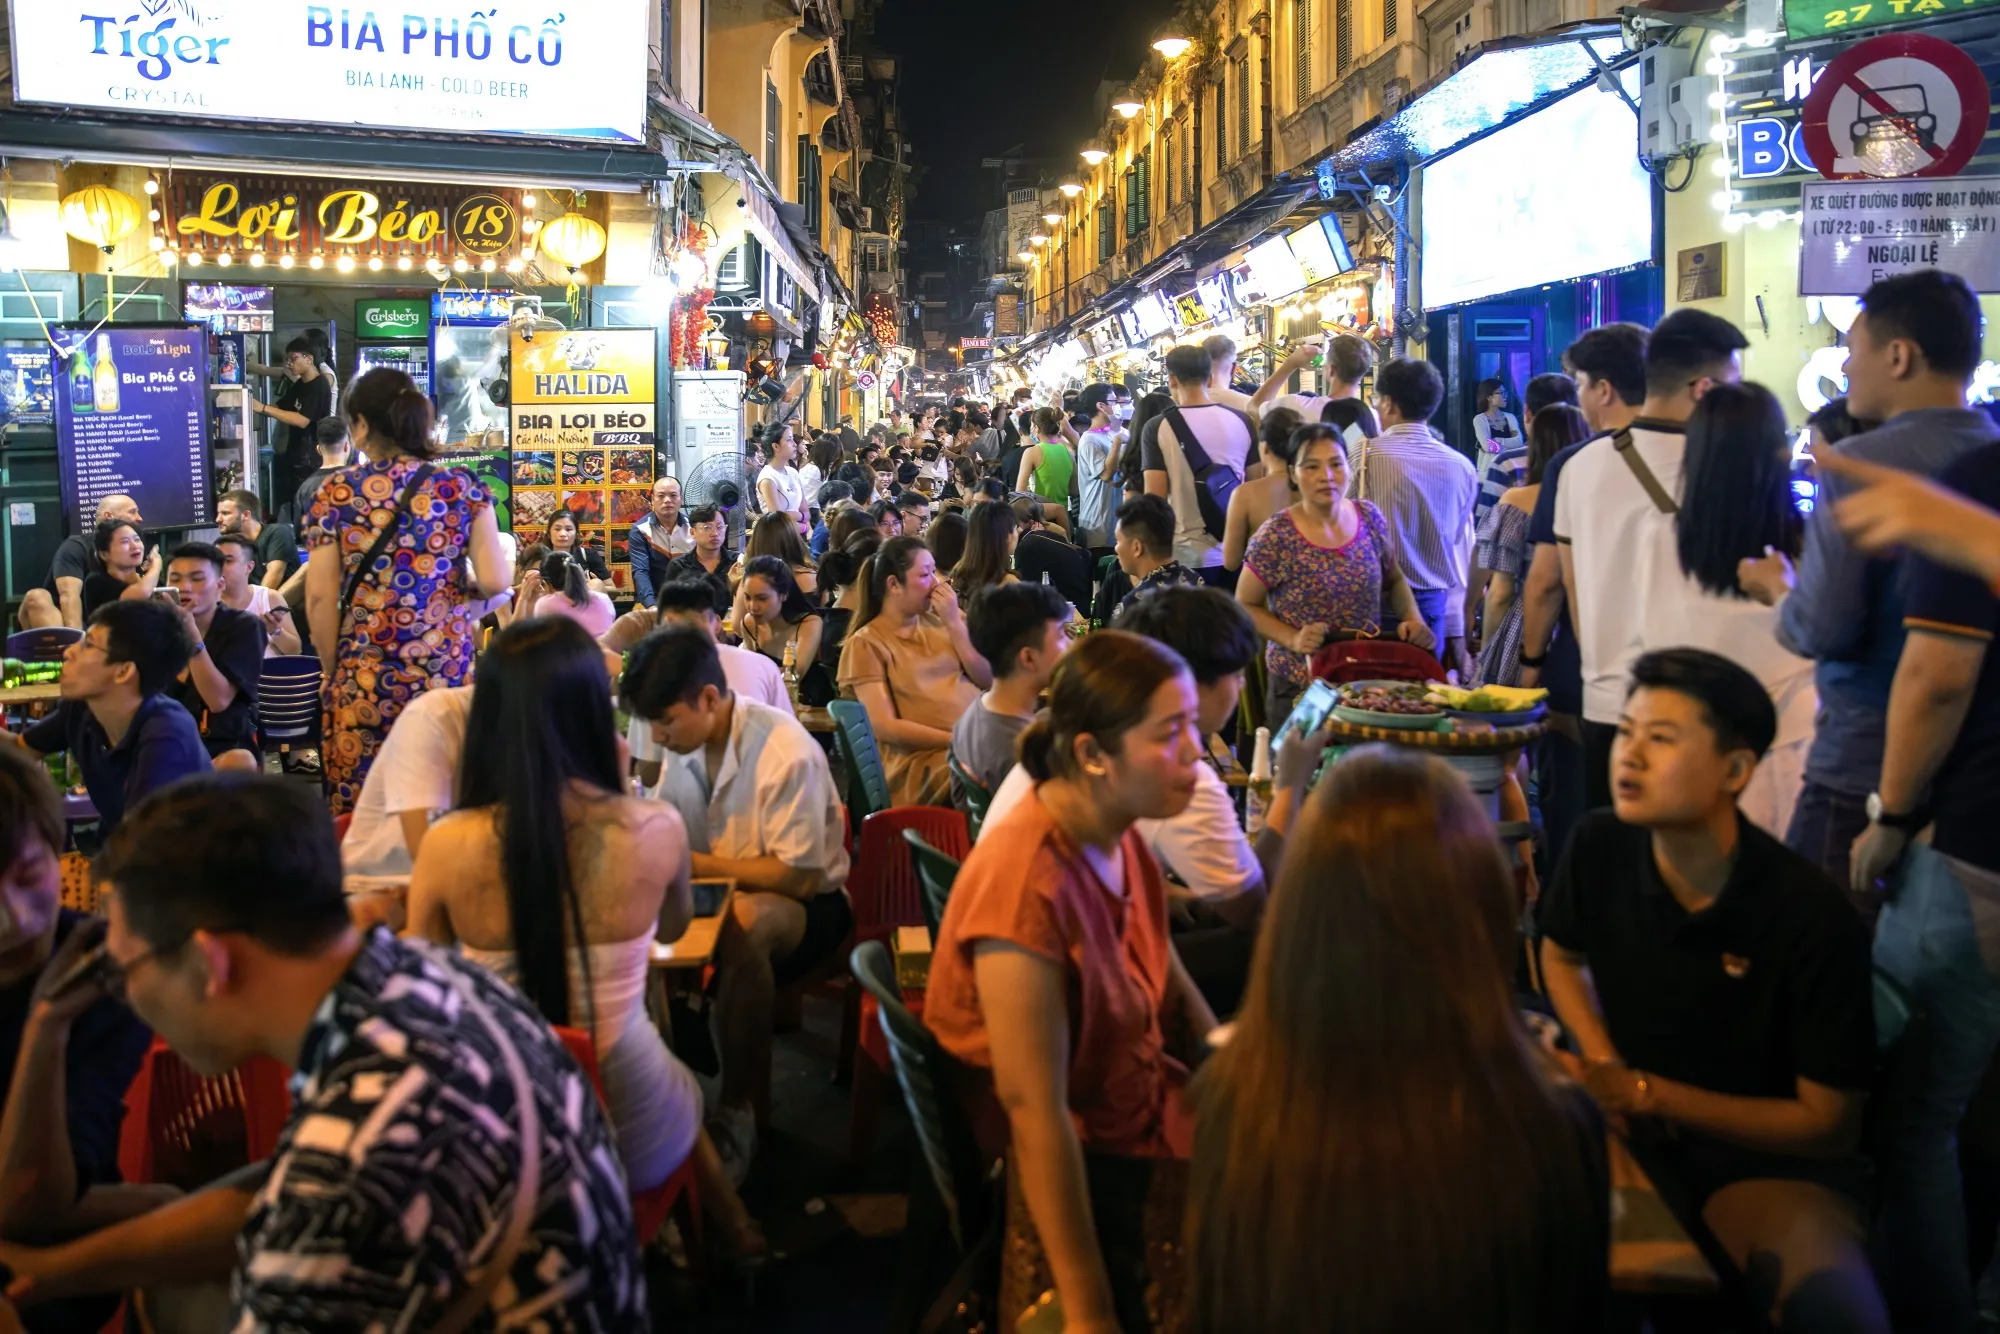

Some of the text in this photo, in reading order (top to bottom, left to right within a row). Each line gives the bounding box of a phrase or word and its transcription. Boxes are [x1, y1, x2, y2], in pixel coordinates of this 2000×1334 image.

[1824, 4, 1872, 28] 27
[80, 14, 230, 80] Tiger
[307, 6, 565, 66] BIA PHỐ CỔ
[346, 70, 374, 87] BIA
[380, 72, 424, 90] LANH
[442, 77, 483, 95] COLD
[490, 80, 528, 98] BEER
[108, 86, 210, 106] CRYSTAL
[1810, 196, 1824, 210] XE
[1828, 191, 1856, 209] QUÉT
[1936, 192, 1966, 210] HOẠT
[177, 182, 446, 250] Lợi Béo
[463, 204, 508, 236] 18
[1920, 216, 1950, 233] HÀNG
[1868, 240, 1939, 266] NGOẠI LỆ
[366, 308, 420, 325] Carlsberg
[122, 344, 155, 355] BOLD
[163, 344, 191, 358] Light
[123, 367, 196, 384] Bia Phố Cổ
[535, 373, 630, 396] HALIDA
[518, 410, 646, 432] BIA LỢI BÉO
[601, 433, 640, 444] BBQ
